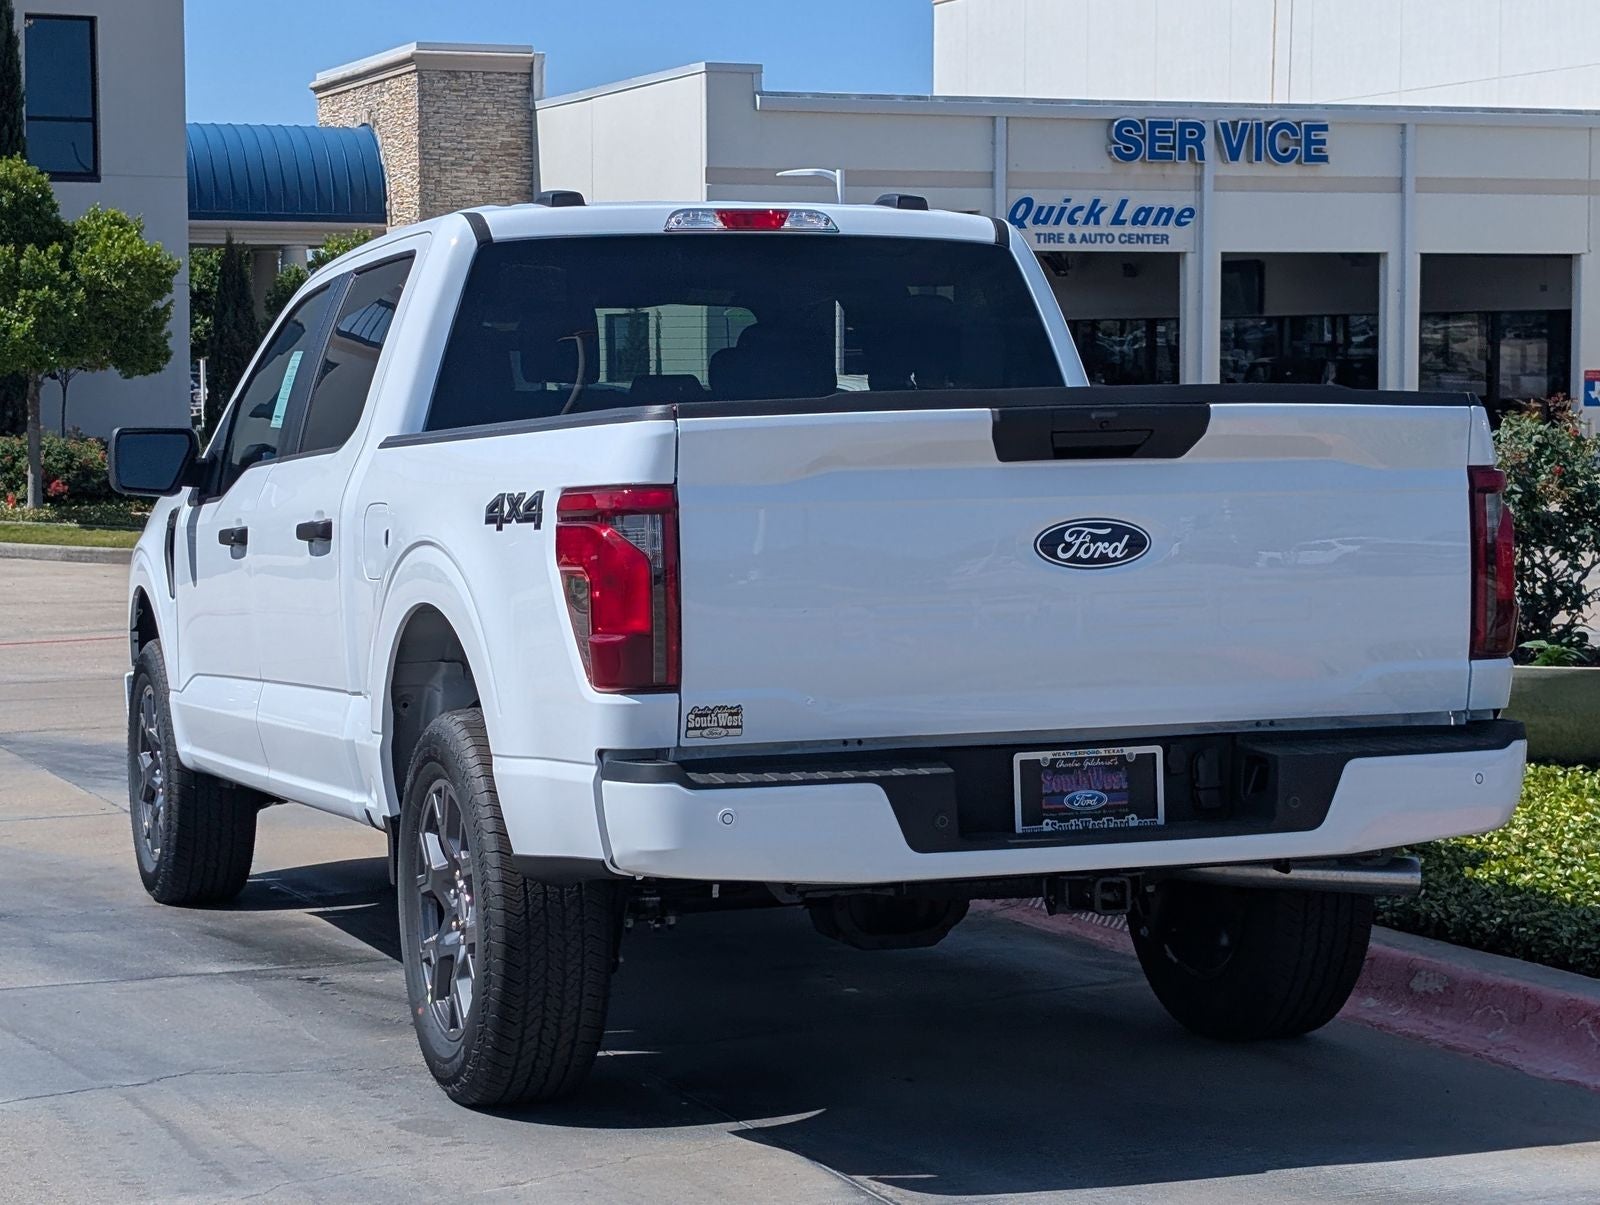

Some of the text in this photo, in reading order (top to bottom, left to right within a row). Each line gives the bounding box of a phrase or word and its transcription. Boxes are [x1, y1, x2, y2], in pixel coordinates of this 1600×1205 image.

[1008, 196, 1196, 230] Quick Lane
[1035, 233, 1169, 245] TIRE & AUTO CENTER
[1057, 527, 1130, 559] Ford
[1073, 793, 1098, 806] Ford
